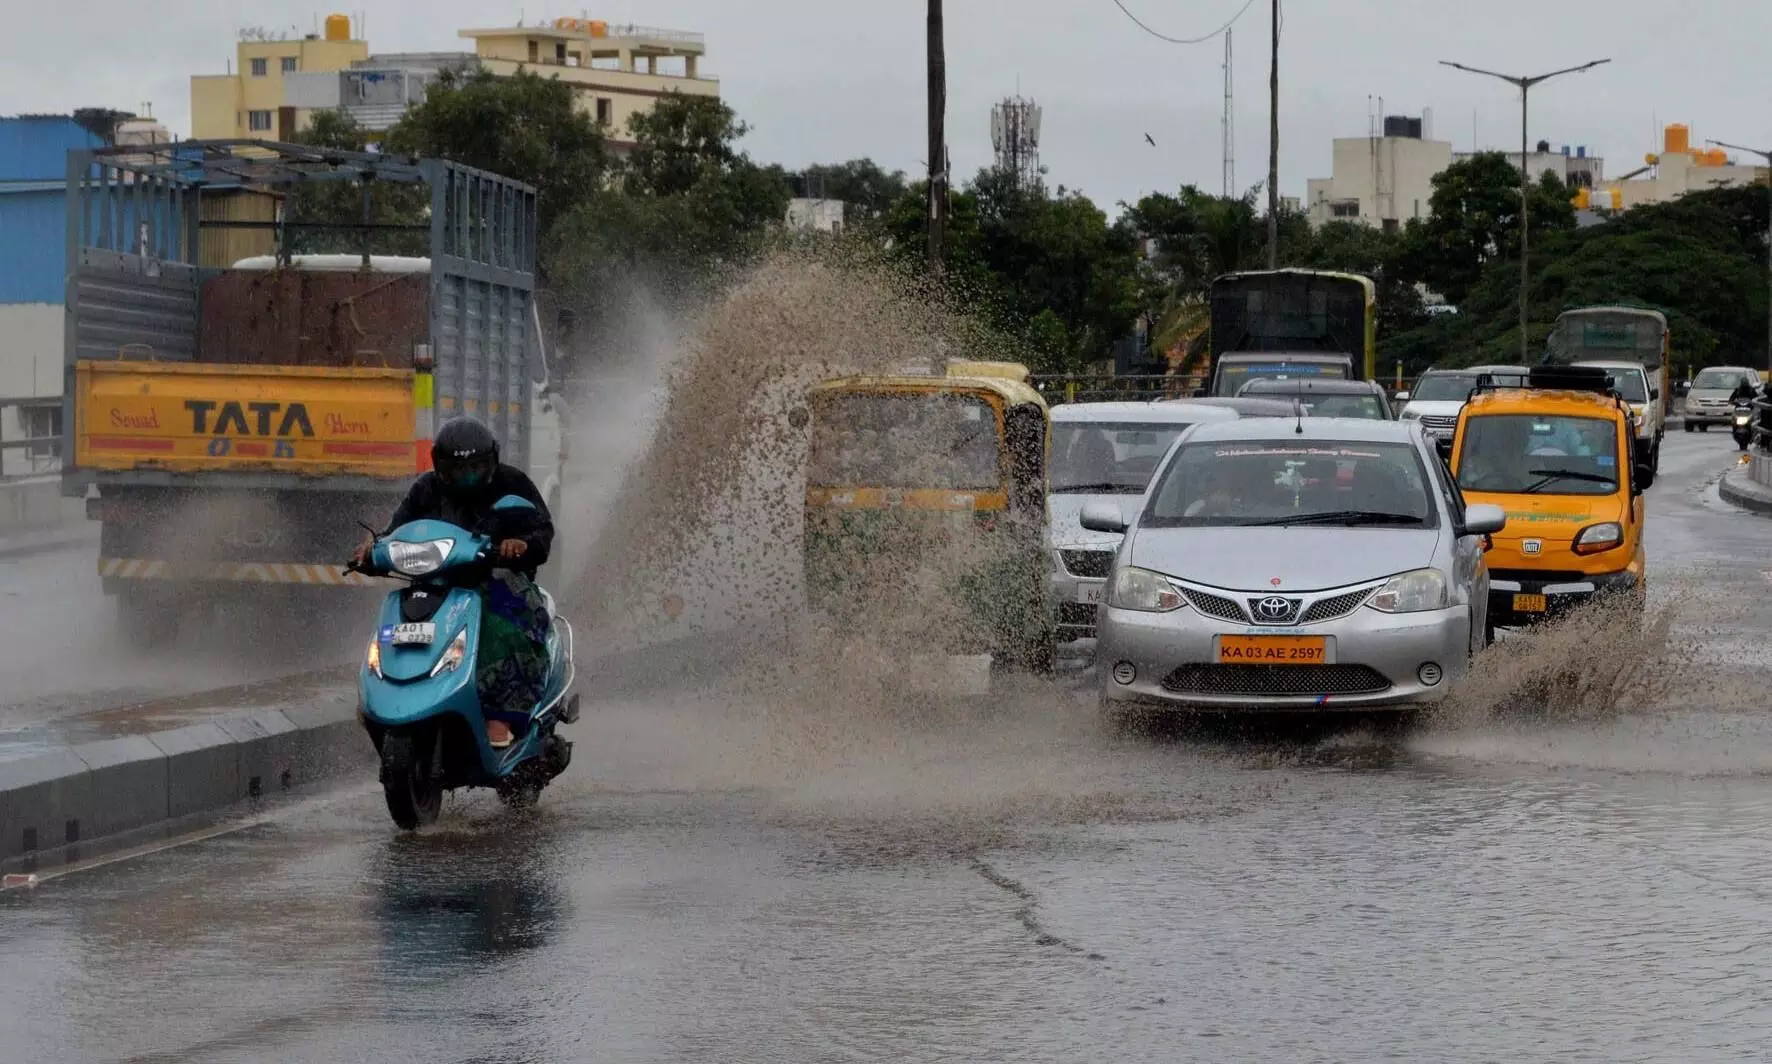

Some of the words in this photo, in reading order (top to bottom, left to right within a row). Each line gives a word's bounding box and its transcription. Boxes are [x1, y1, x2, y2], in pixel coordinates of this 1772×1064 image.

[109, 406, 161, 429] Sound
[184, 399, 316, 437] TATA
[323, 412, 370, 435] Horn
[1221, 646, 1243, 658] KA
[1246, 647, 1262, 658] 03
[1264, 648, 1287, 658] AE
[1290, 647, 1323, 659] 2597
